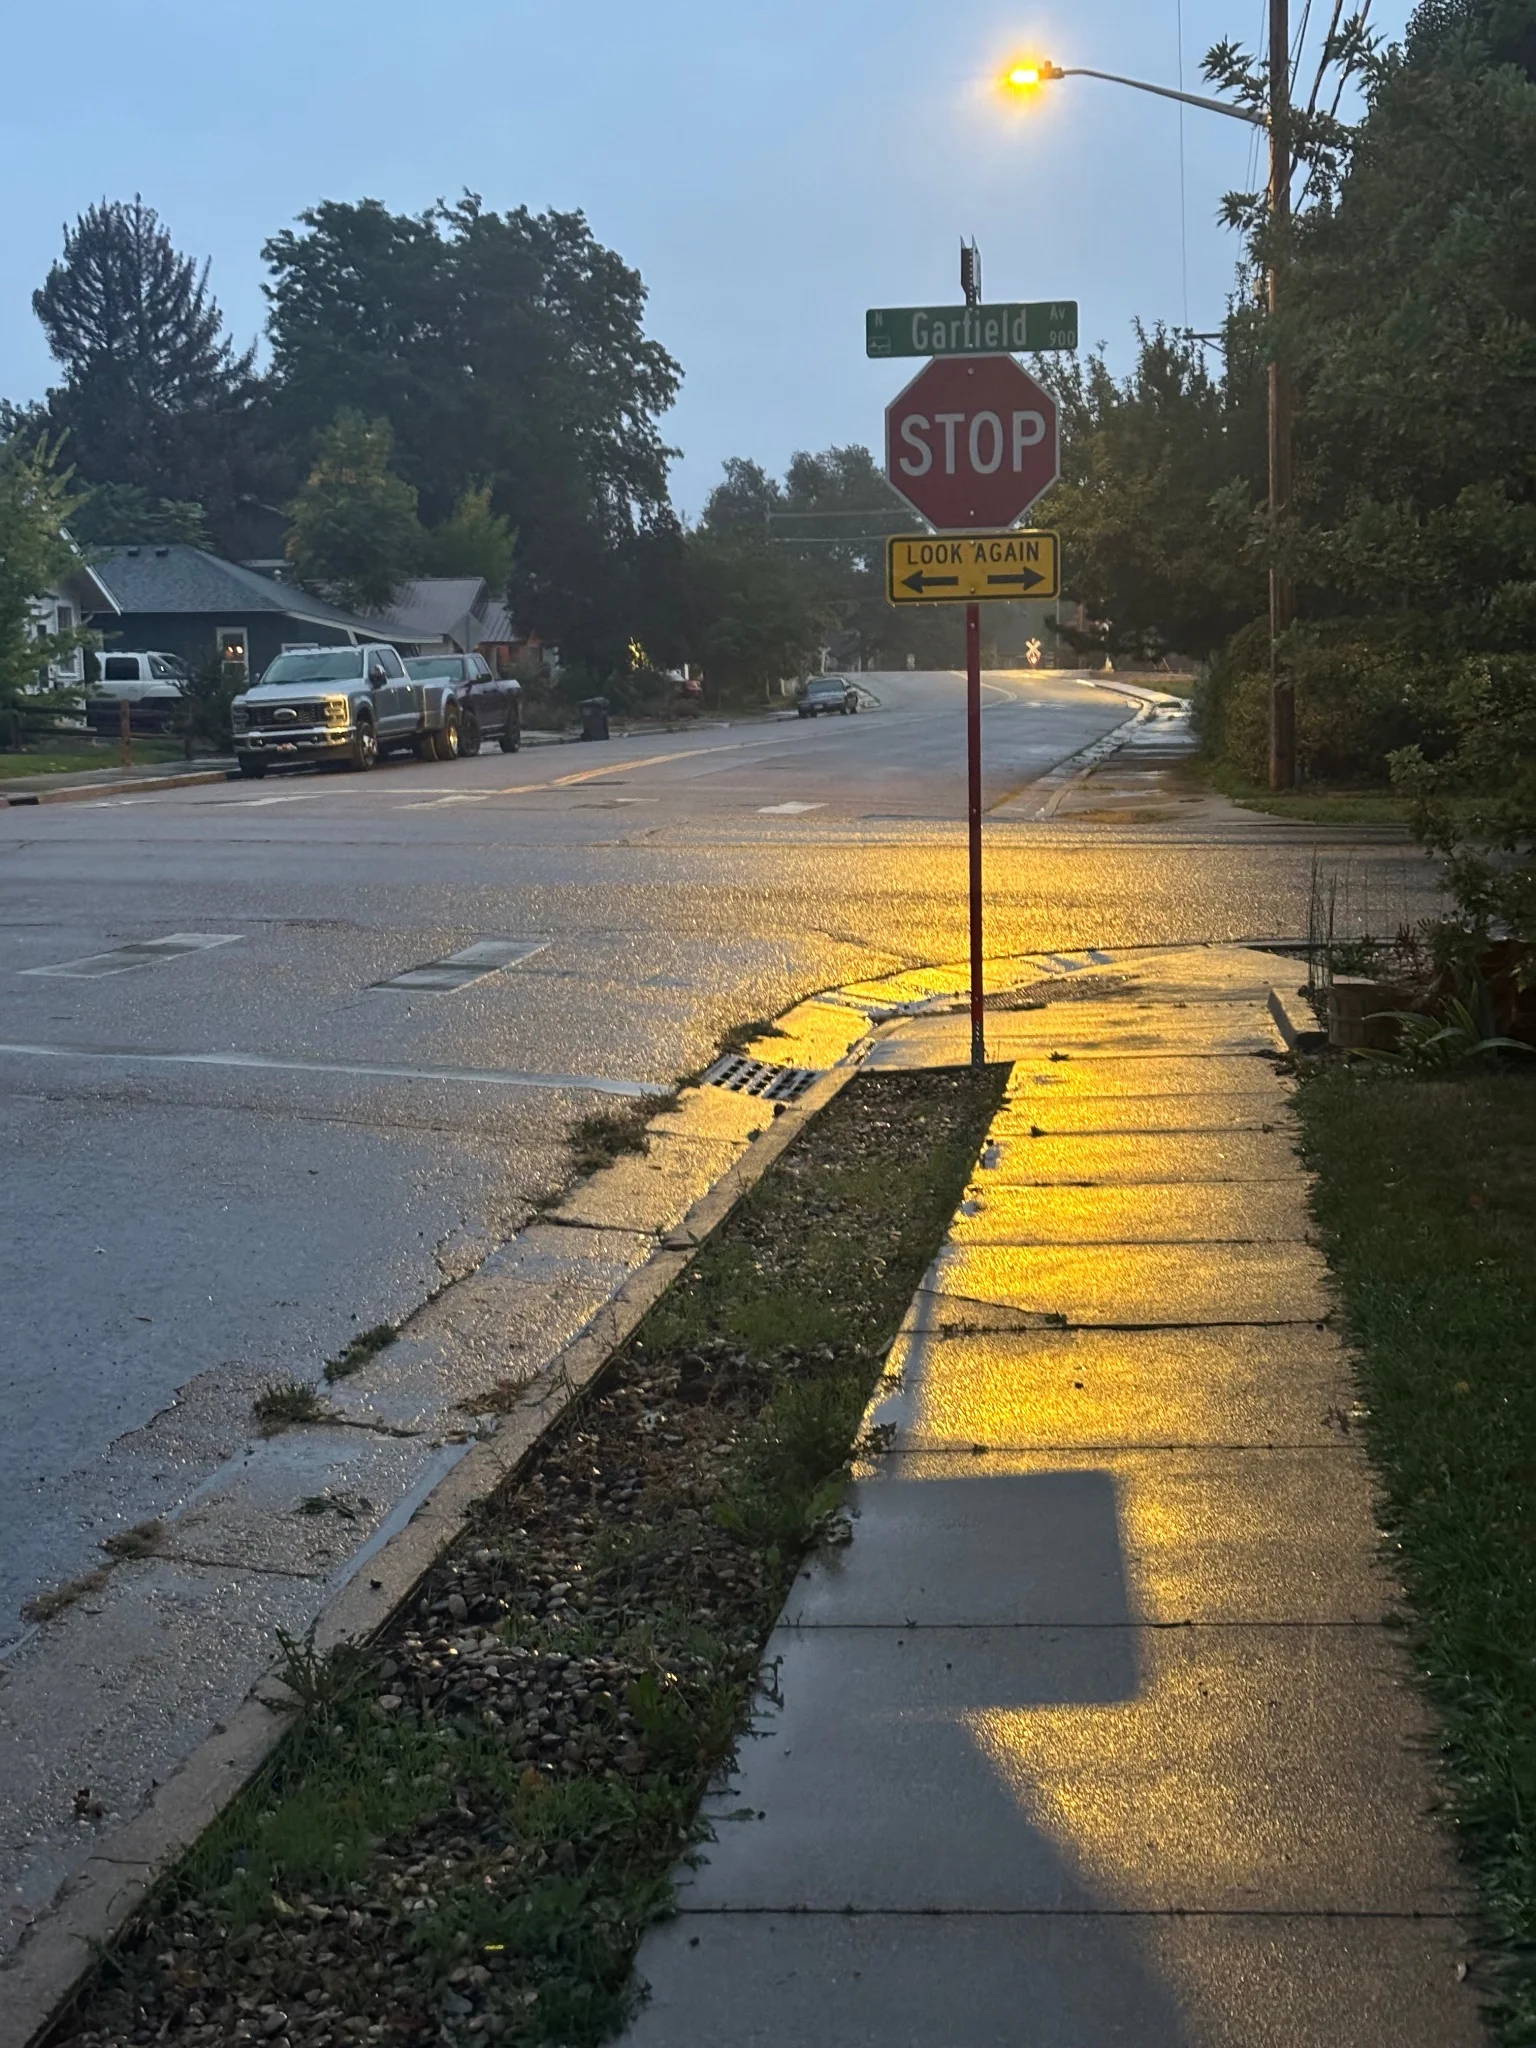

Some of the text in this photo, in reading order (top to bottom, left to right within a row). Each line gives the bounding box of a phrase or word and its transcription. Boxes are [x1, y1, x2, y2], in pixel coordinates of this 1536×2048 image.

[912, 308, 1027, 350] Garfield
[1050, 303, 1066, 320] Av
[1050, 330, 1076, 347] 900
[899, 411, 1046, 477] STOP
[907, 541, 1040, 565] LOOK AGAIN
